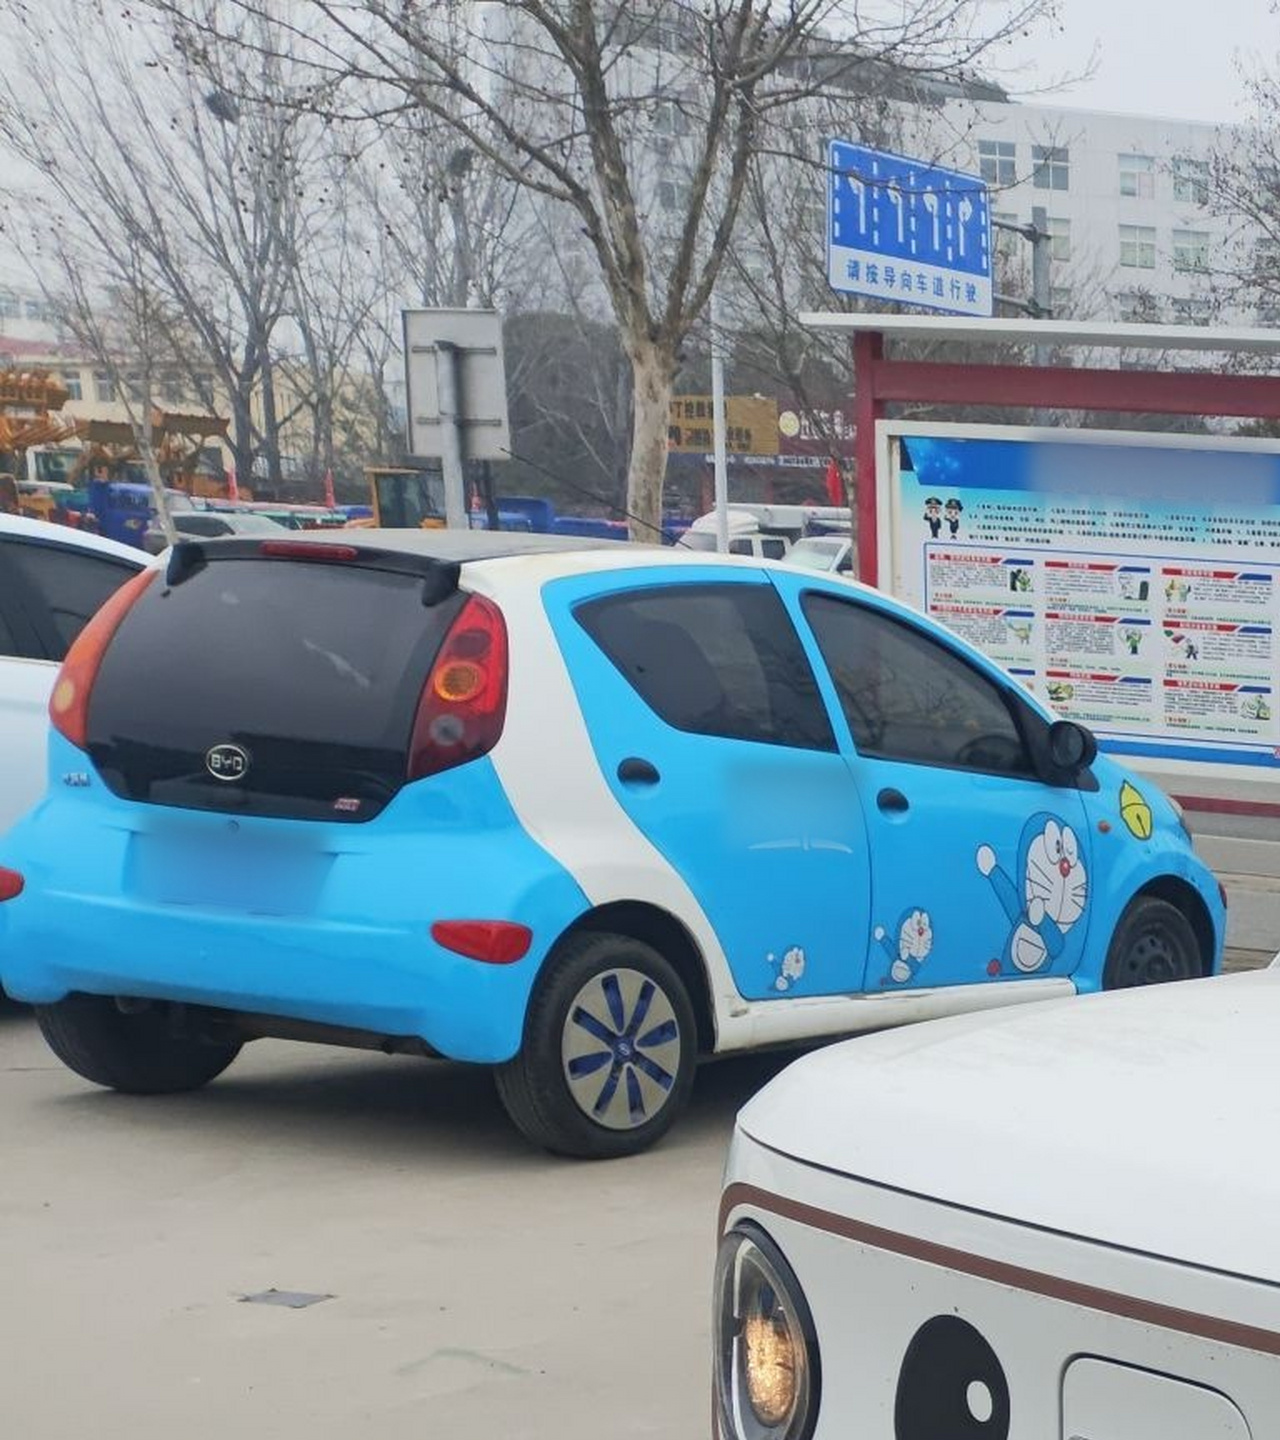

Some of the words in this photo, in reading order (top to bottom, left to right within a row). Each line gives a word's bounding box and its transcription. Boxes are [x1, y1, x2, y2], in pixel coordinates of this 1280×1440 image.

[846, 259, 977, 303] 请按导向车道行驶
